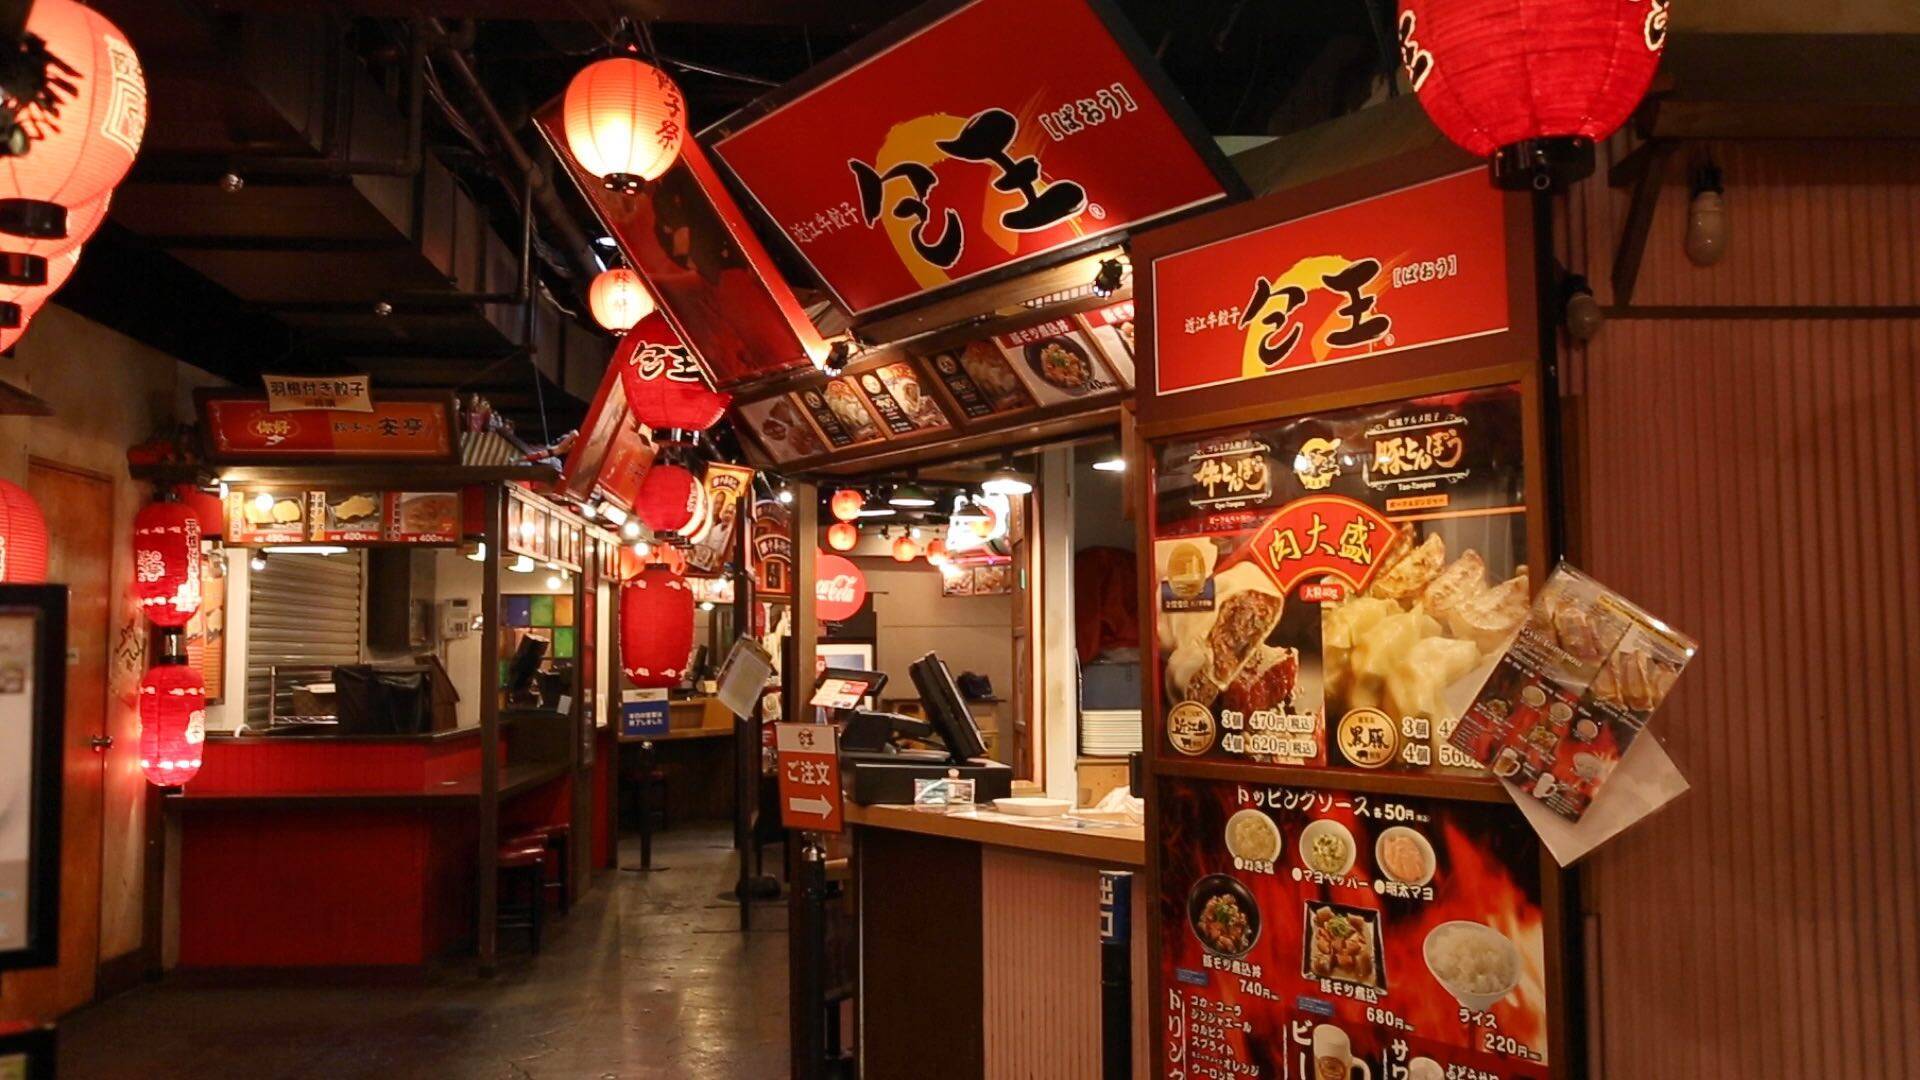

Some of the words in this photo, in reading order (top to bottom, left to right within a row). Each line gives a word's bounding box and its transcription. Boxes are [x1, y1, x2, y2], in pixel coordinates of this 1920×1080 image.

[1268, 512, 1375, 570] 肉大盛
[1221, 710, 1243, 729] 3個
[1402, 717, 1429, 738] 3個
[1222, 733, 1245, 753] 4個
[1403, 743, 1430, 764] 4個
[787, 761, 831, 786] ご注文
[1237, 785, 1371, 817] トッピングソース
[1459, 1008, 1498, 1029] ライス
